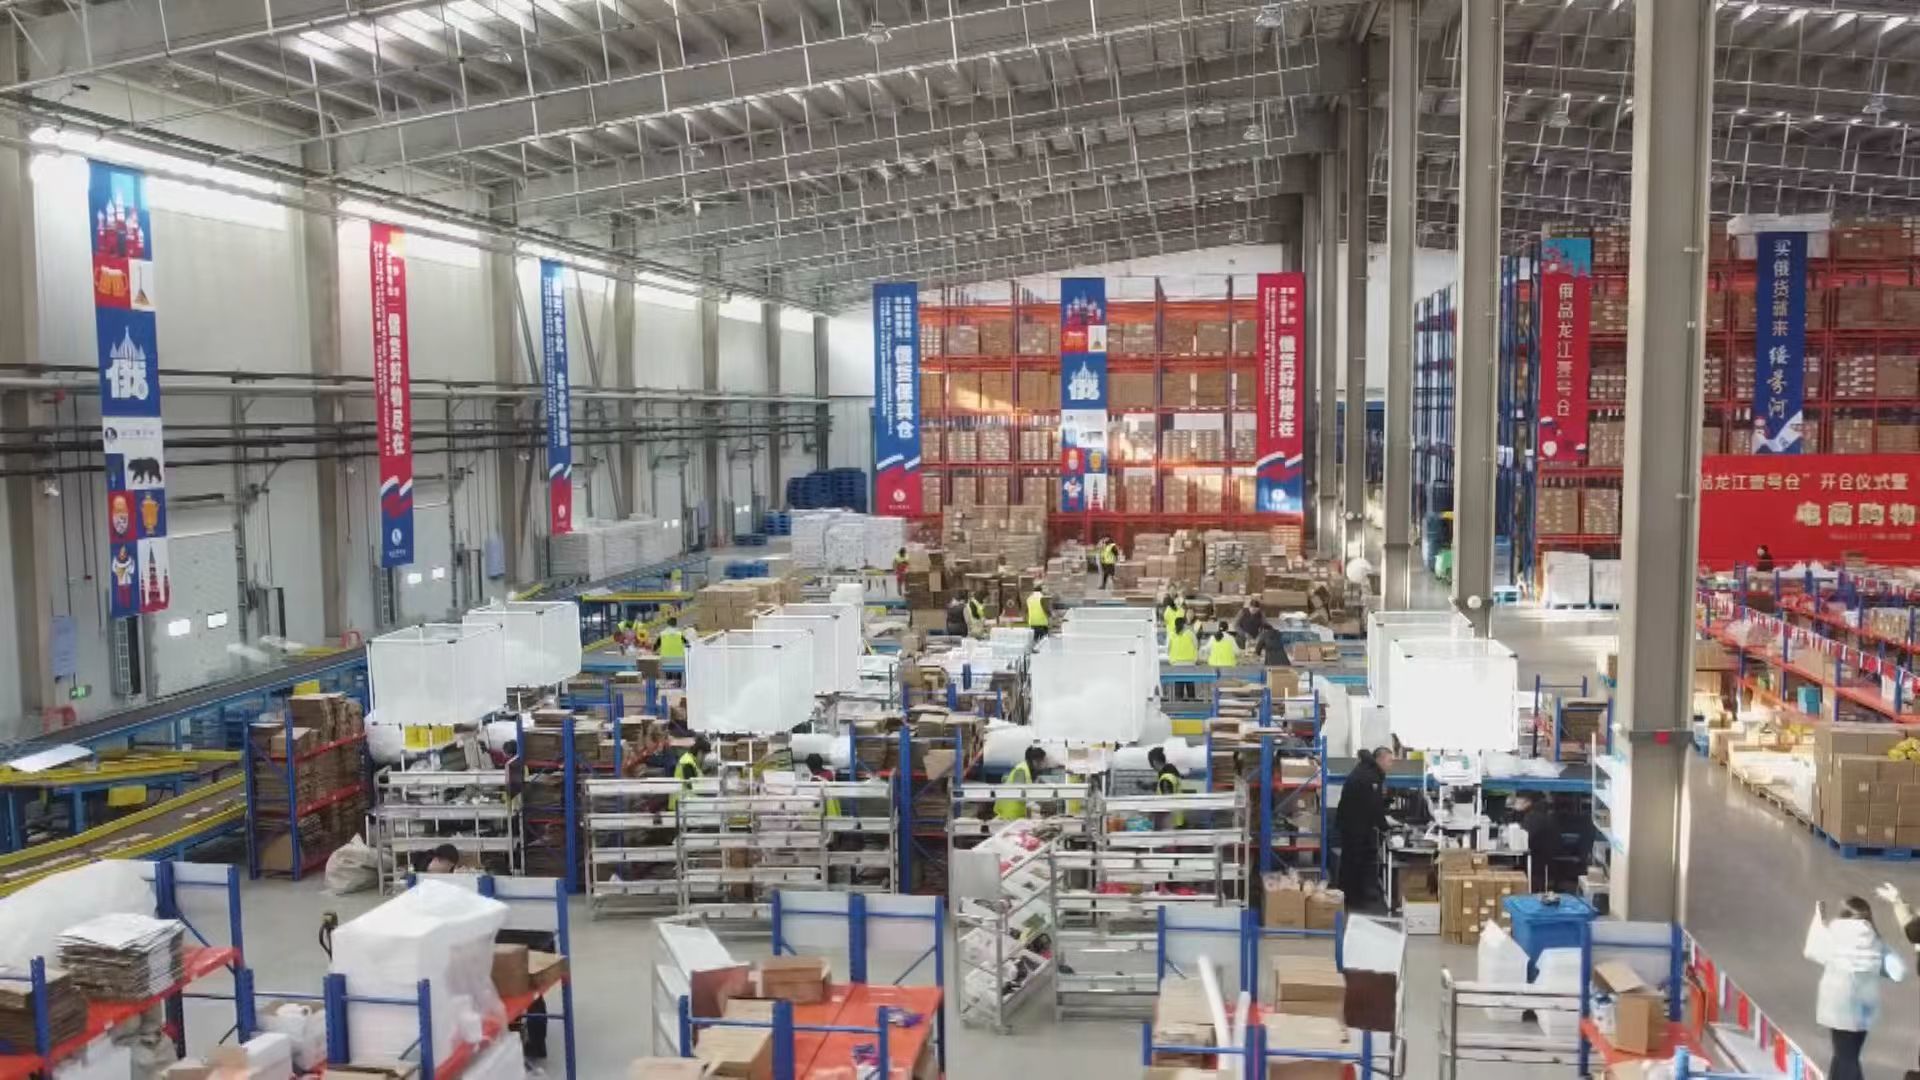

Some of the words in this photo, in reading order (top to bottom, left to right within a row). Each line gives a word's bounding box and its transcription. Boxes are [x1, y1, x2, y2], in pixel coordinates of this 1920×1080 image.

[1557, 283, 1573, 417] 俄品龙江壹号仓
